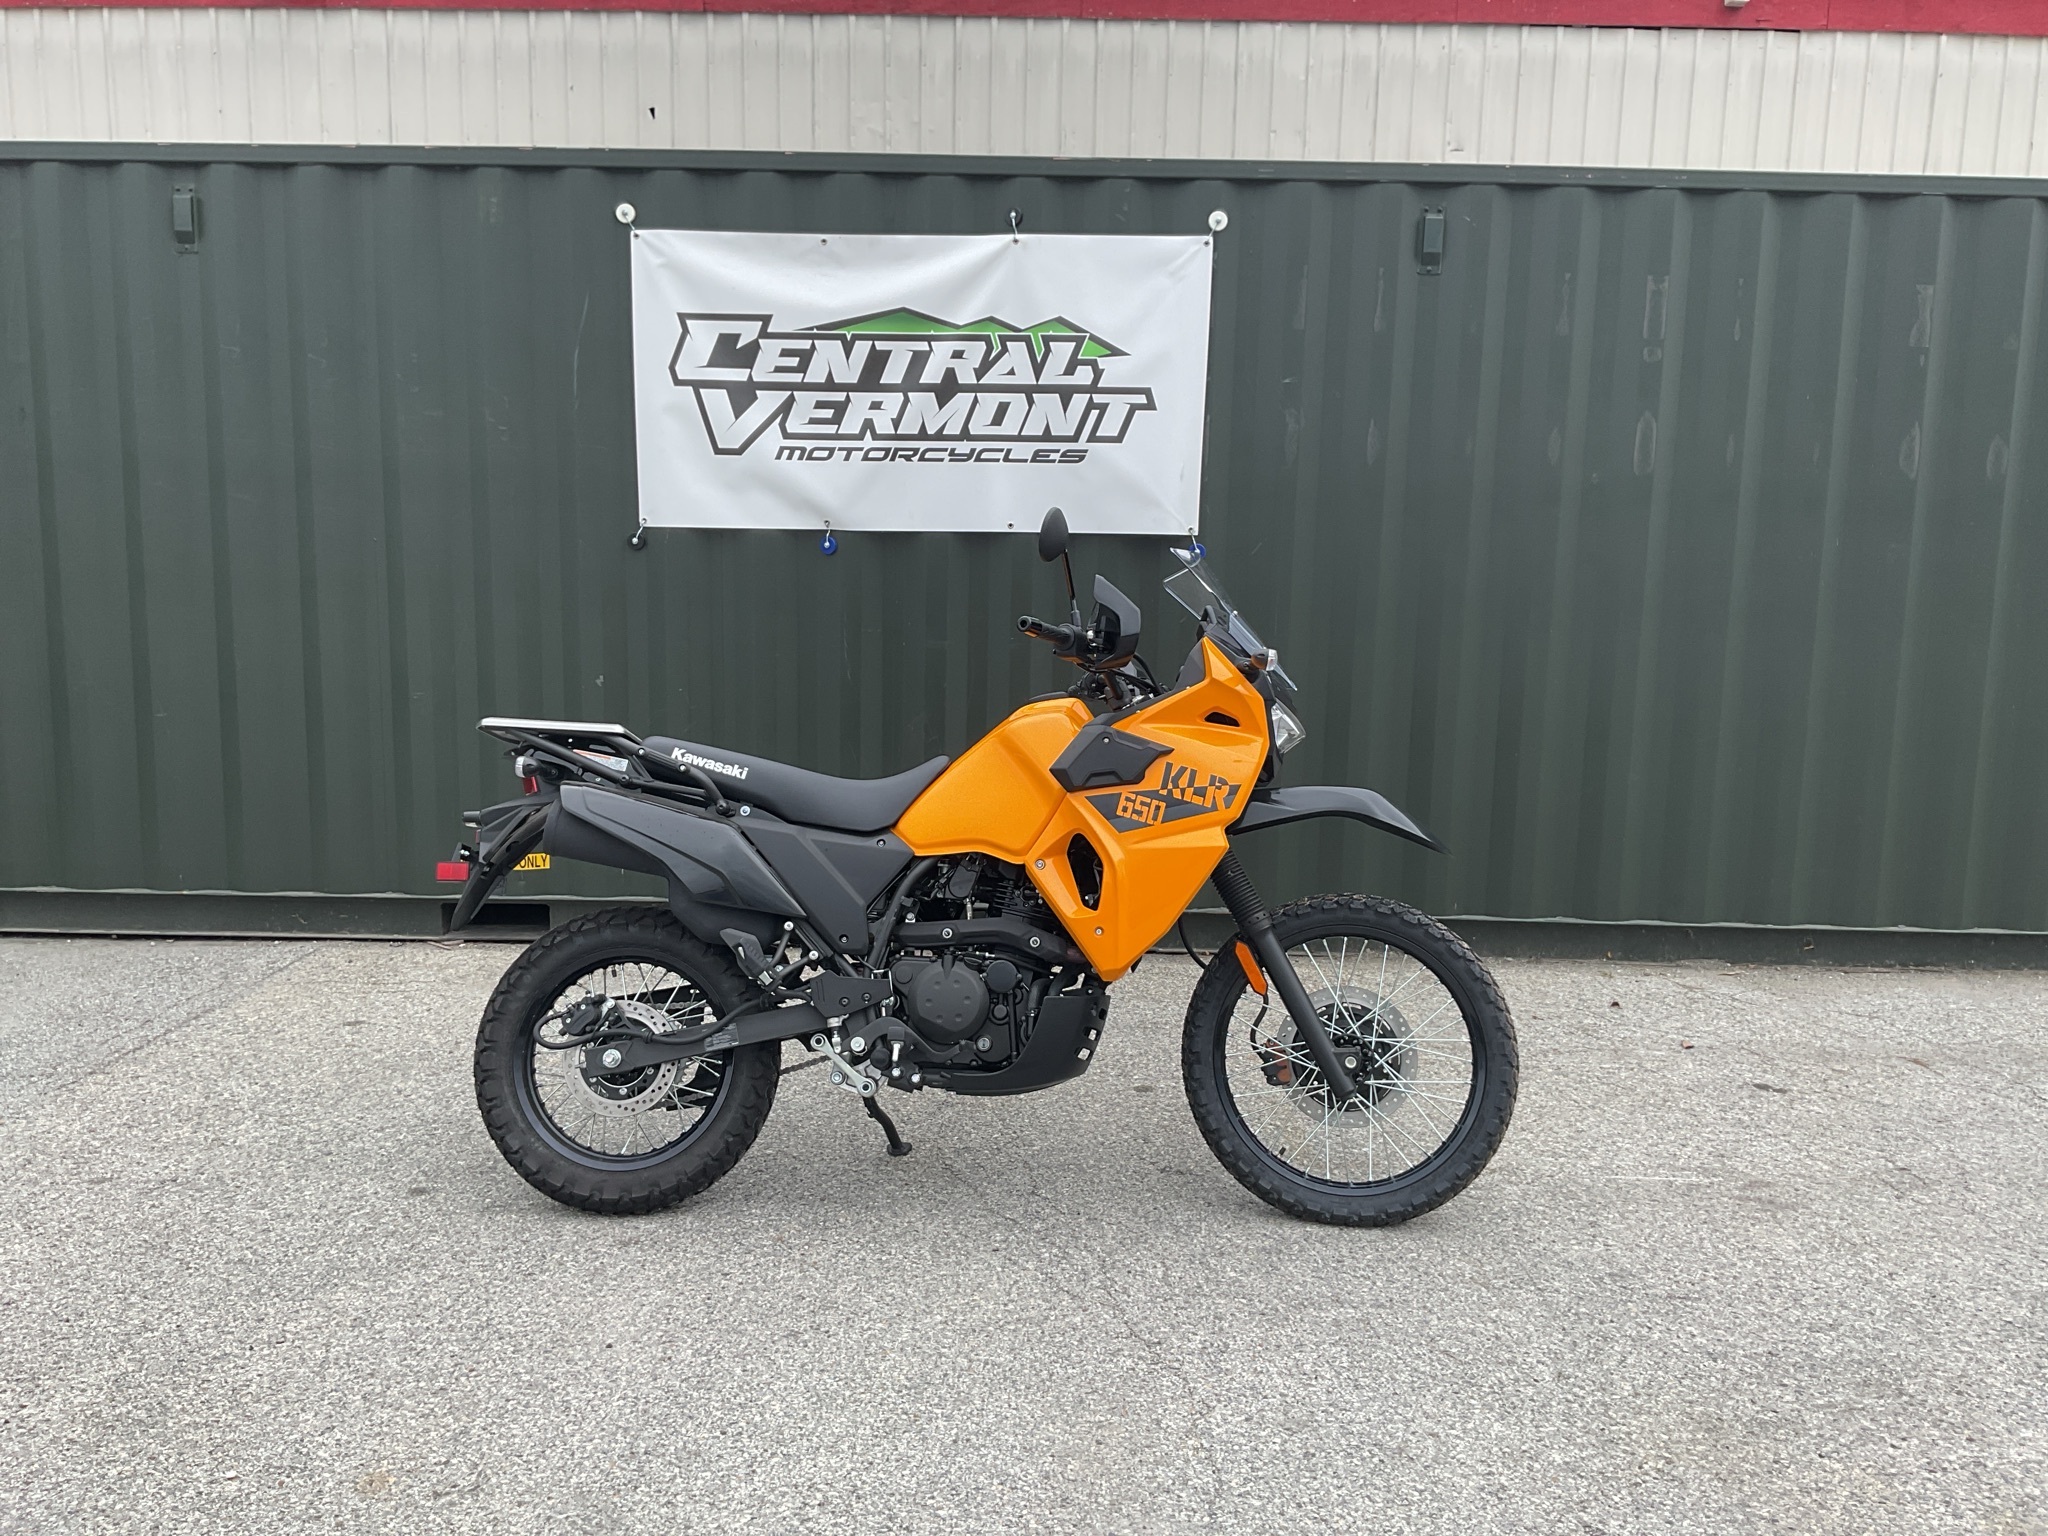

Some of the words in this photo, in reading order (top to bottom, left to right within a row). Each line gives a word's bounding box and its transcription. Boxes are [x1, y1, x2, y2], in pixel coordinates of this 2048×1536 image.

[672, 315, 1102, 385] CENTRAL
[697, 387, 1151, 453] VERMONT
[775, 445, 1089, 464] MOTORCYCLES
[670, 747, 749, 780] Kawasaki
[1159, 761, 1230, 809] KLR
[1116, 792, 1166, 826] 650
